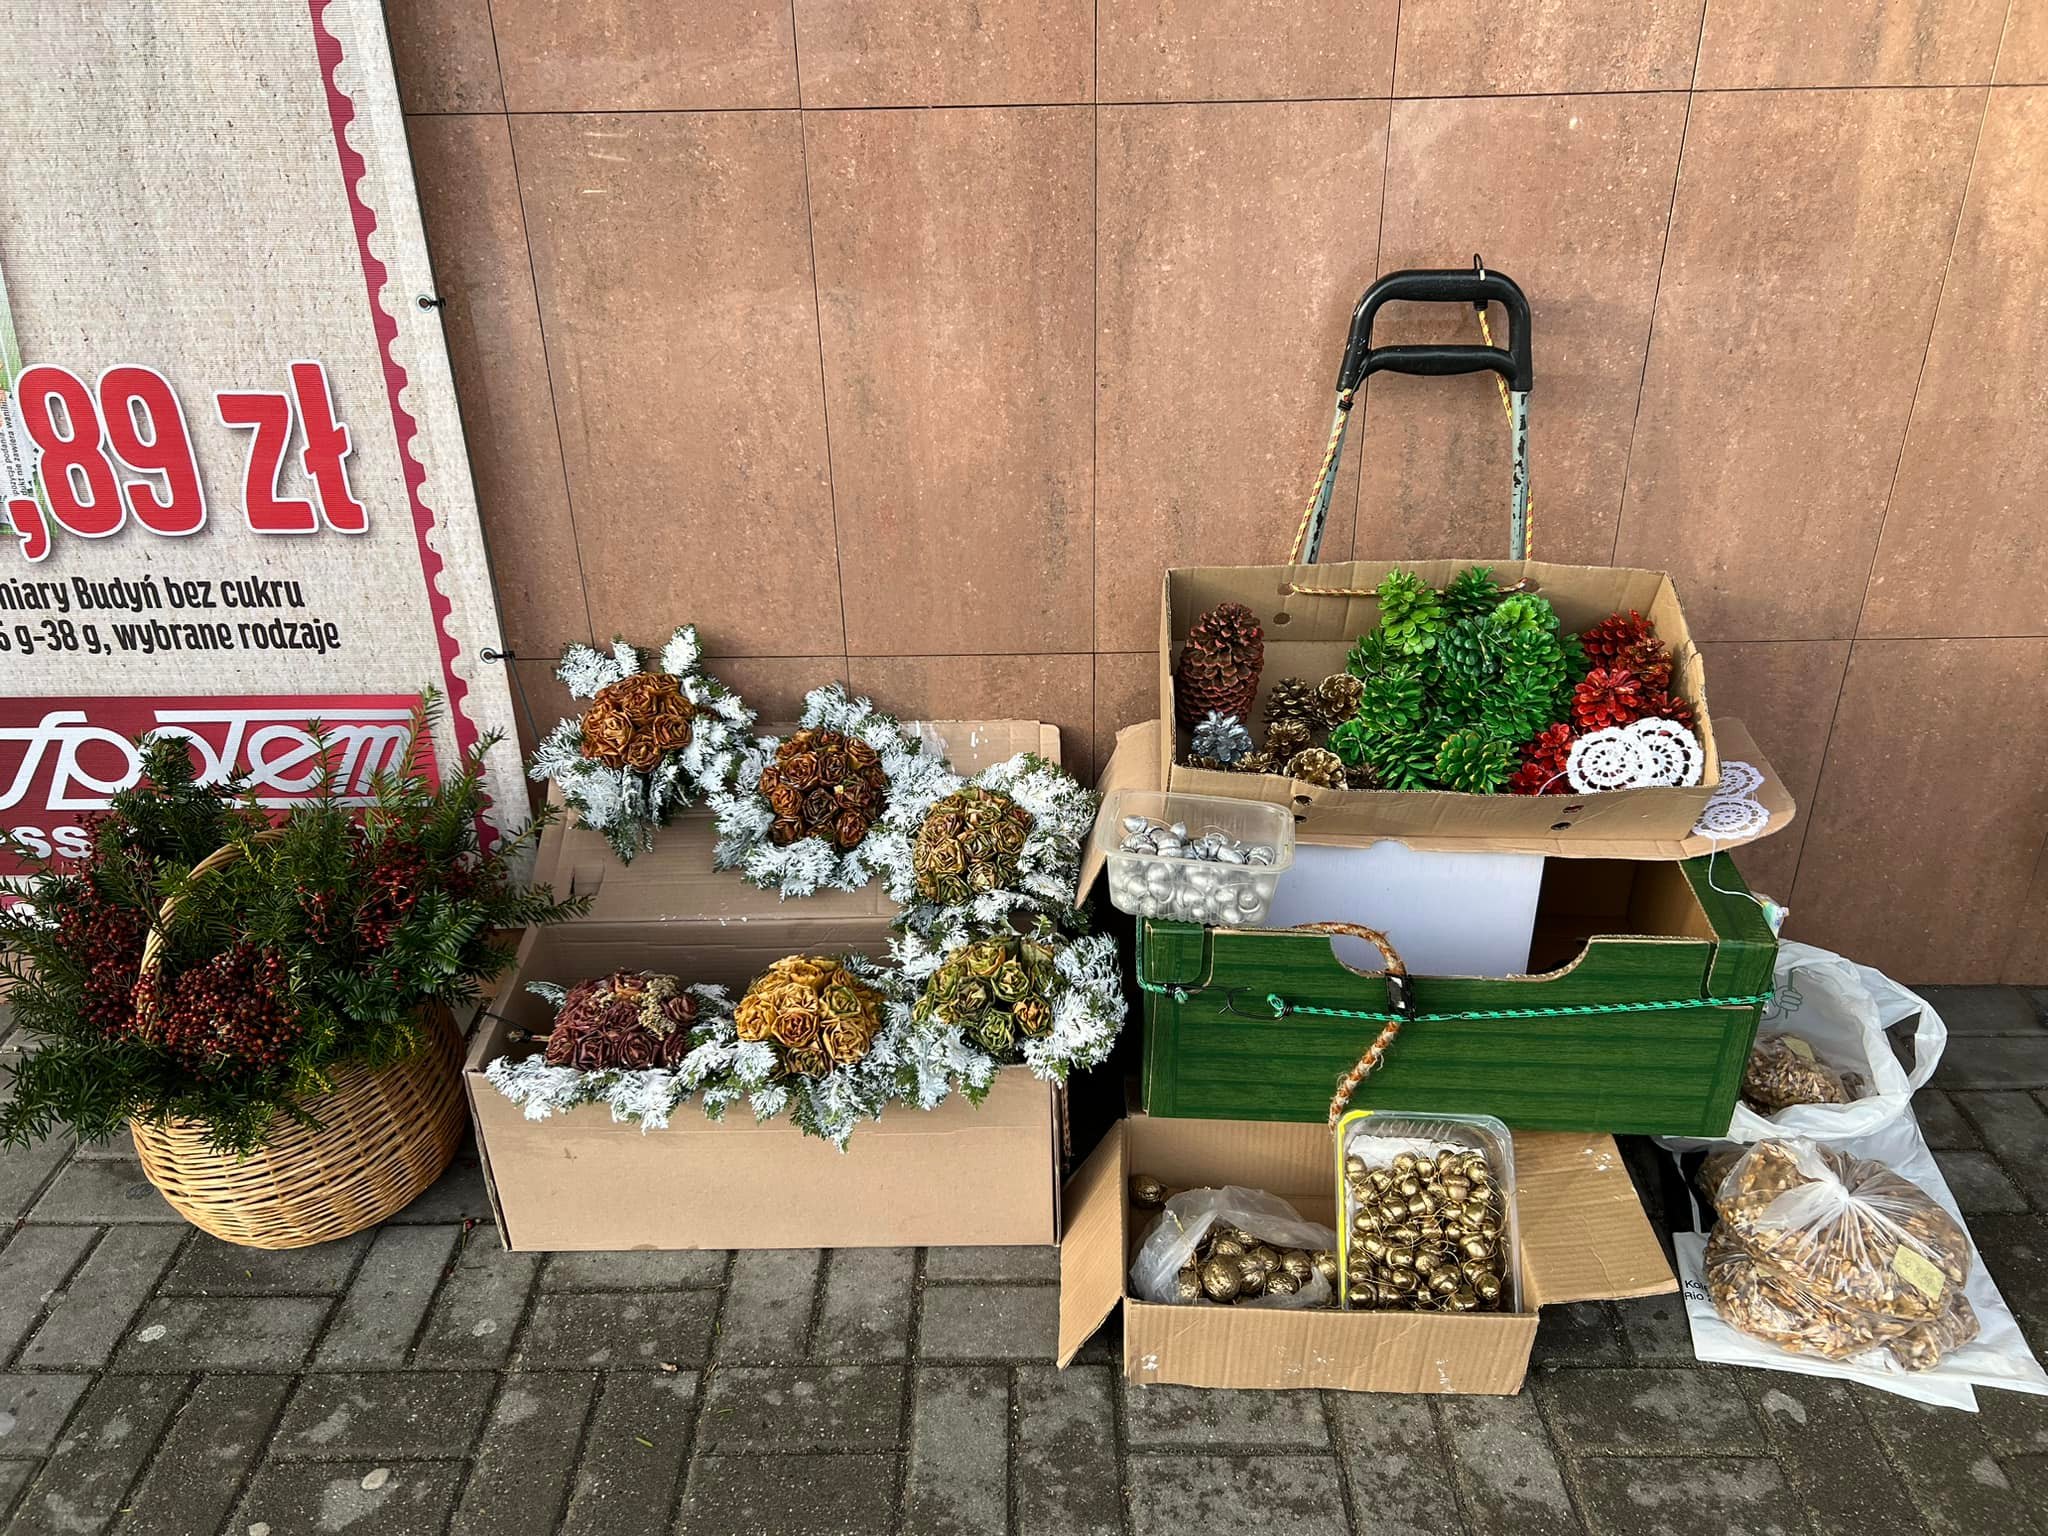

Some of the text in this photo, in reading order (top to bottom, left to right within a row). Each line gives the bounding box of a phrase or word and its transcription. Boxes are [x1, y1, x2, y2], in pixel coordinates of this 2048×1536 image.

[216, 361, 368, 533] zł
[71, 574, 163, 611] Budyń
[164, 576, 217, 608] bez
[220, 575, 305, 608] cukru
[15, 619, 79, 655] g-38
[82, 624, 112, 656] g,
[112, 620, 234, 655] wybrane
[240, 618, 342, 655] rodzaje
[1684, 1291, 1704, 1301] Rio
